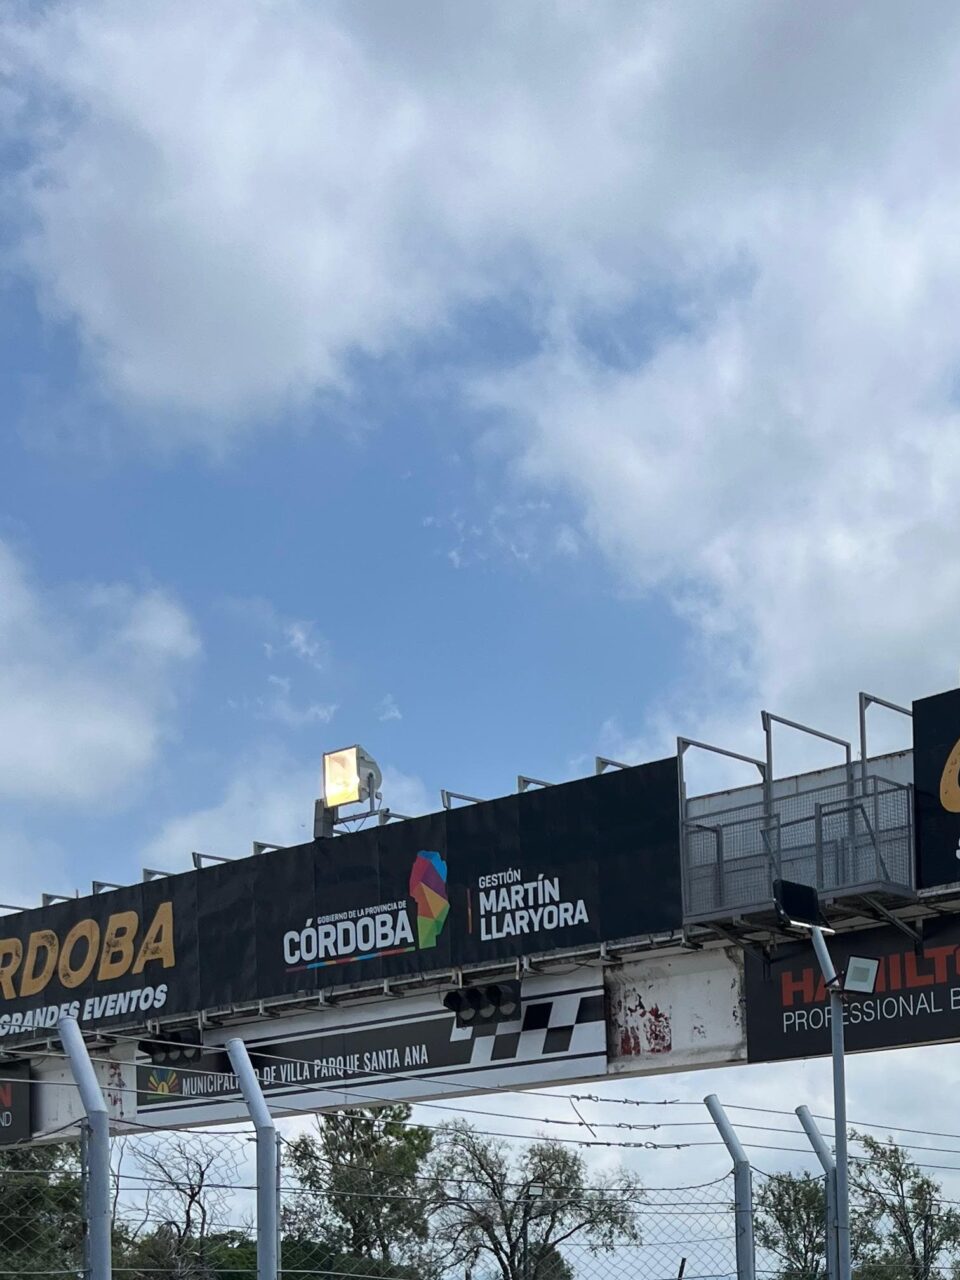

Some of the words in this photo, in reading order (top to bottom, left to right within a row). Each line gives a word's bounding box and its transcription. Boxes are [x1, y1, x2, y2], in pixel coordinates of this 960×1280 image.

[478, 867, 521, 889] GESTIÓN
[479, 874, 560, 916] MARTÍN
[317, 911, 347, 925] GOBIERNO
[348, 909, 356, 919] DE
[357, 908, 365, 917] LA
[398, 900, 406, 909] DE
[480, 899, 590, 941] LLARYORA
[283, 909, 415, 964] CÓRDOBA
[82, 984, 168, 1021] EVENTOS
[263, 1065, 276, 1086] DE
[280, 1063, 310, 1083] VILLA
[313, 1055, 360, 1078] PARQUE
[363, 1049, 400, 1072] SANTA
[404, 1044, 429, 1067] ANA
